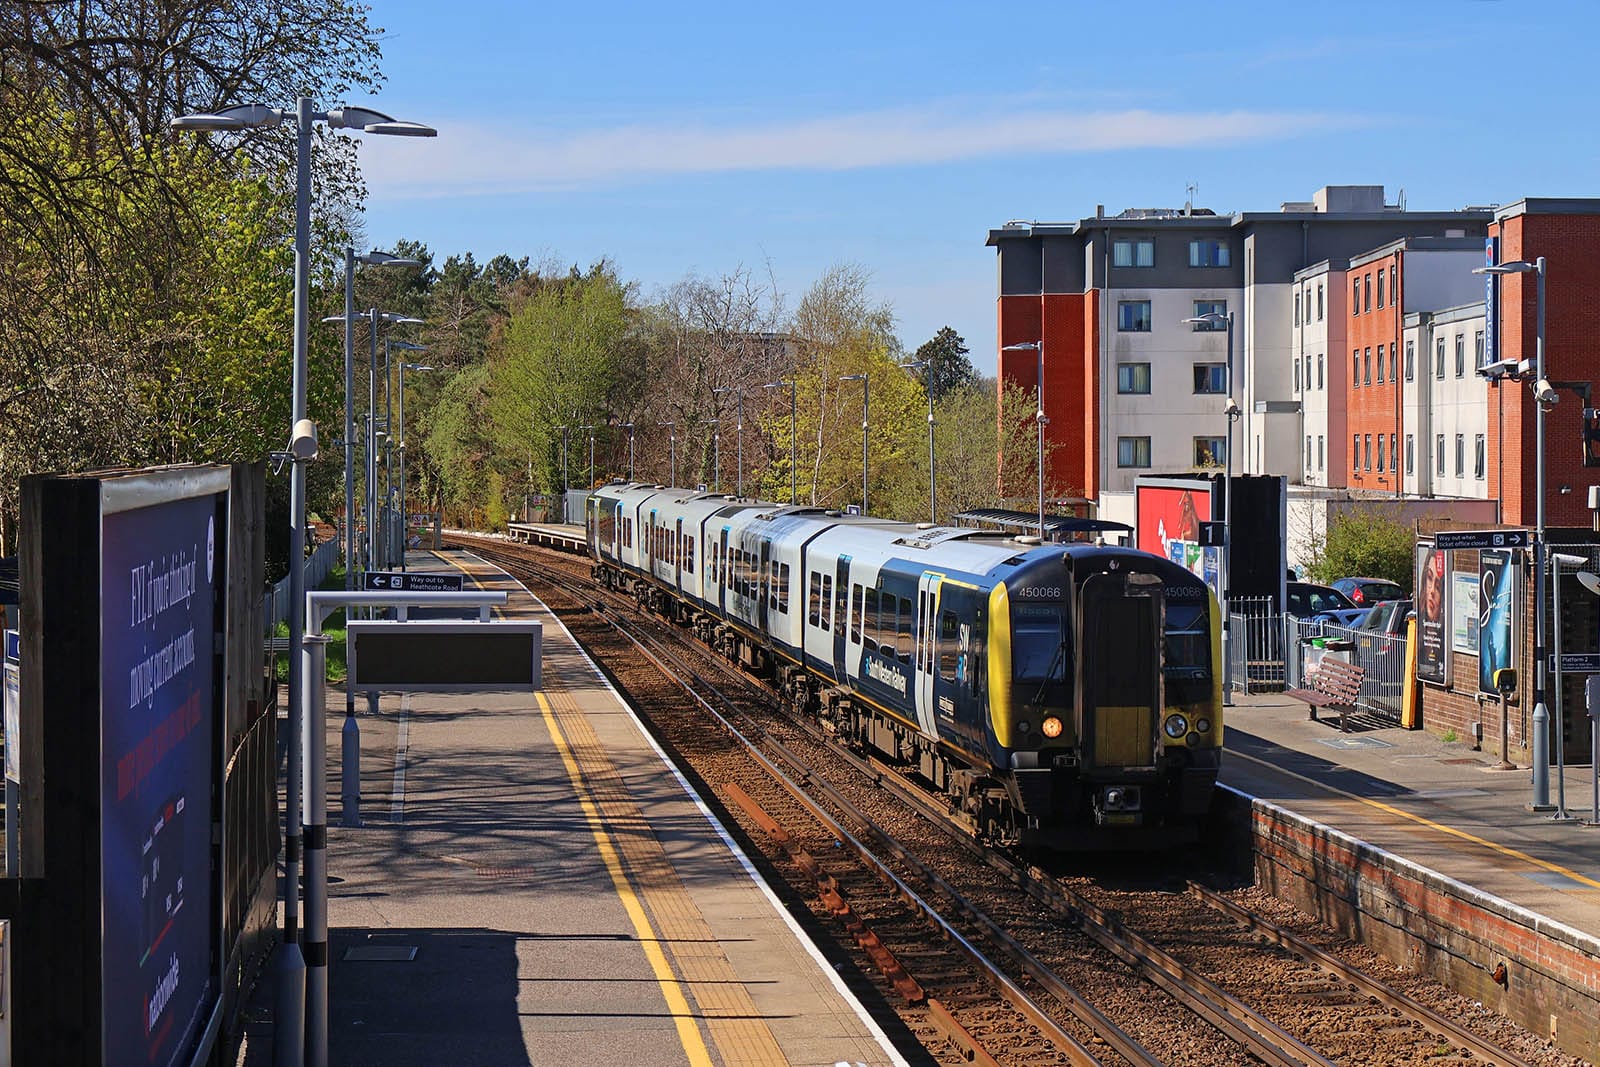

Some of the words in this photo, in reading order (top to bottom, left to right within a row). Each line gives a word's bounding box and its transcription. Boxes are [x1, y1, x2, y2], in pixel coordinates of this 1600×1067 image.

[1205, 525, 1212, 543] 1
[410, 576, 424, 584] Way
[410, 583, 442, 591] Heathcote
[1019, 587, 1061, 598] 450066
[1165, 586, 1201, 597] 450066
